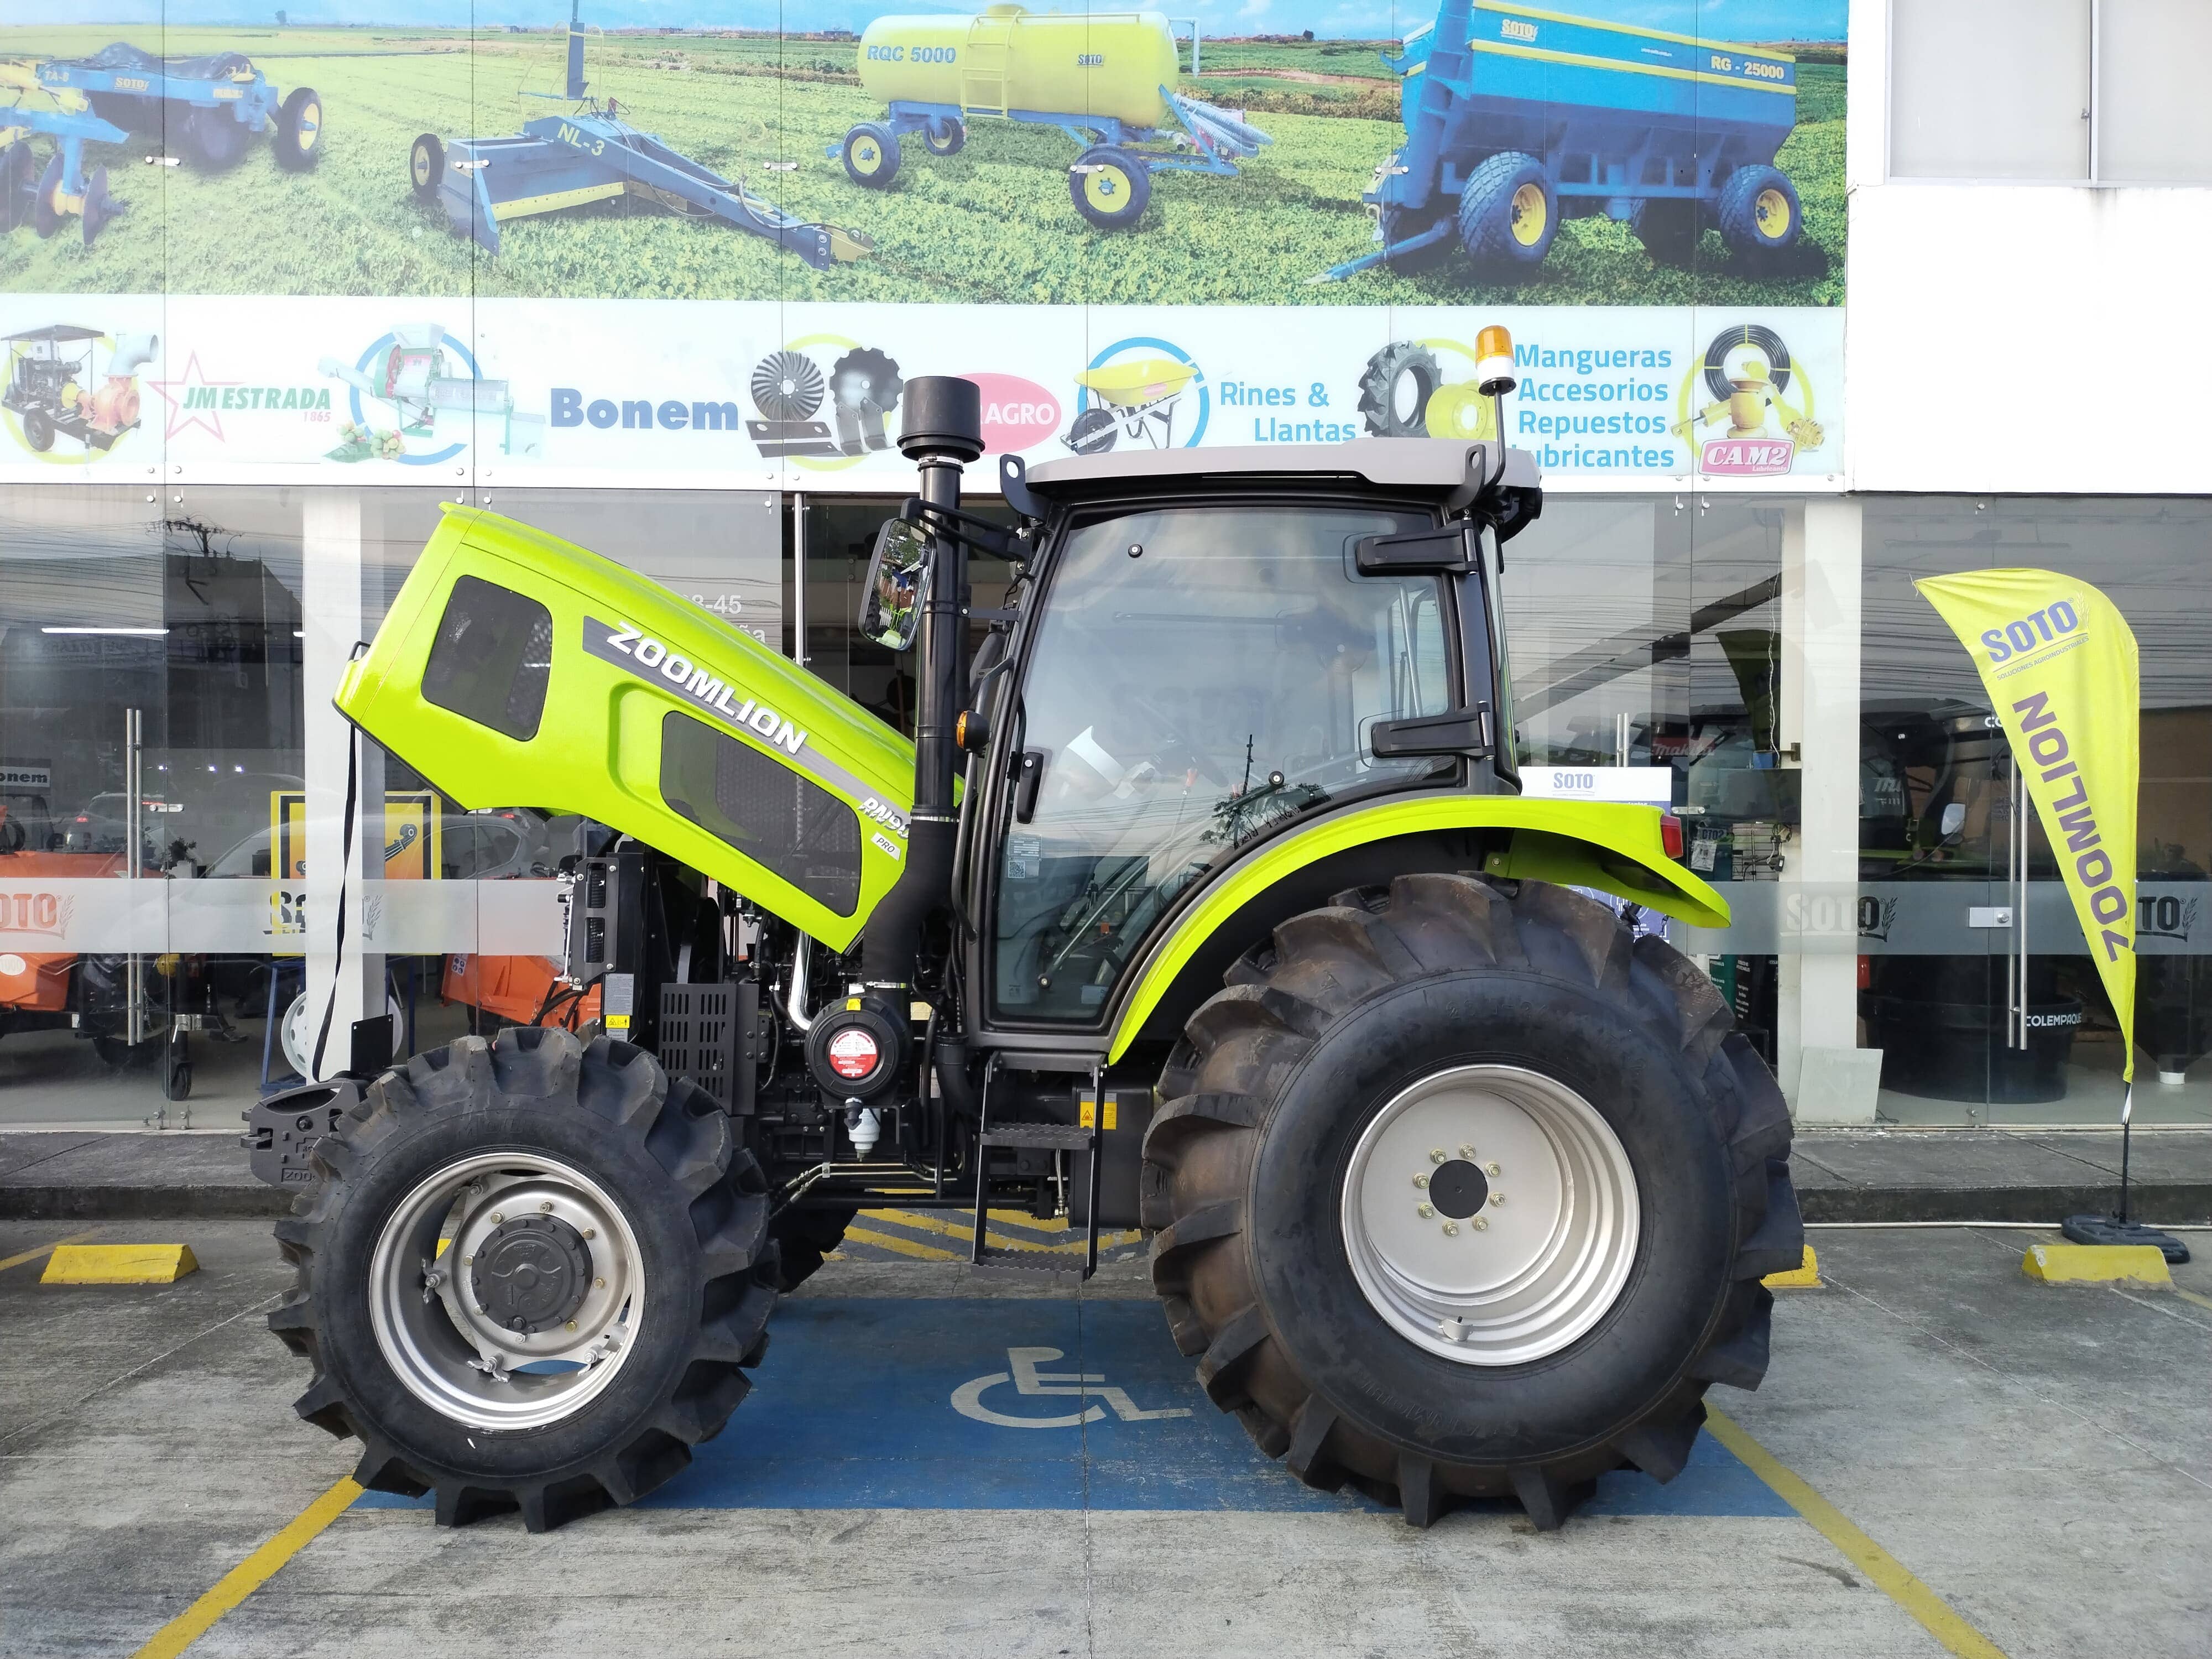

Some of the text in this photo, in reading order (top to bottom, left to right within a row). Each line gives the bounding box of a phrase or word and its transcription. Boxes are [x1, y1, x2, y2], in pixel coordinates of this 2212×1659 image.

[1502, 19, 1533, 38] SOTO
[867, 45, 956, 63] RQC 5000
[1078, 54, 1102, 64] SOTO
[1711, 56, 1732, 71] RG
[1744, 61, 1785, 80] 25000
[557, 123, 606, 156] NL-3
[1515, 344, 1671, 375] Mangueras
[1220, 382, 1331, 407] Rines &
[1517, 377, 1668, 401] Accesorios
[302, 411, 331, 423] 1865
[551, 388, 739, 431] Bonem
[980, 403, 1055, 425] AGRO
[1254, 418, 1357, 442] Llantas
[1519, 410, 1666, 441] Repuestos
[1512, 443, 1674, 467] bricantes
[1707, 446, 1787, 466] CAM2
[684, 594, 742, 614] 8-45
[1981, 601, 2078, 662] SOTO
[1996, 636, 2089, 681] SOLUCIONES AGROINDUSTRIALES
[606, 620, 808, 756] ZOOMLION
[1553, 772, 1593, 789] SOTO
[2011, 690, 2136, 963] ZOOMLION
[876, 837, 895, 853] PRO
[1787, 893, 1880, 931] SOTO
[284, 1171, 315, 1182] ZOO
